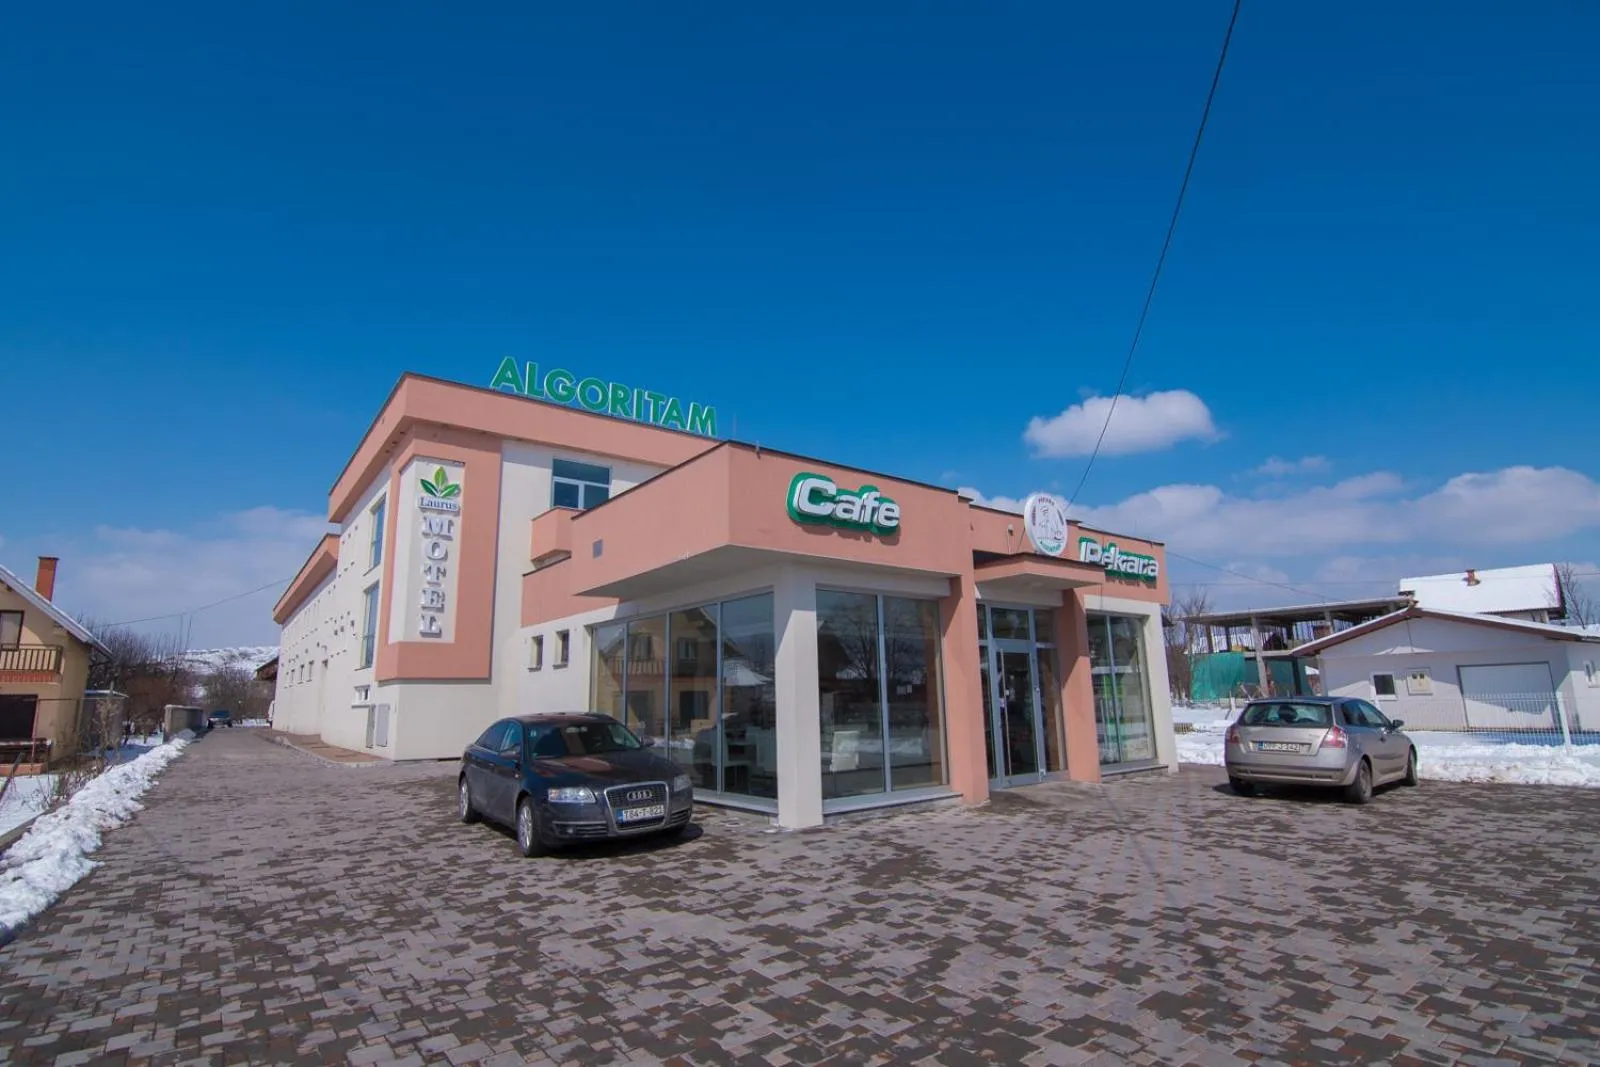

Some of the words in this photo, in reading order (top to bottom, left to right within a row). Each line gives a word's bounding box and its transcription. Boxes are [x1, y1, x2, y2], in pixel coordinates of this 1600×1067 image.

[490, 356, 717, 436] ALGORITAM
[419, 496, 459, 511] Laurus
[793, 478, 900, 527] Cafe
[420, 514, 455, 638] MOTEL
[1080, 541, 1159, 577] Pekara
